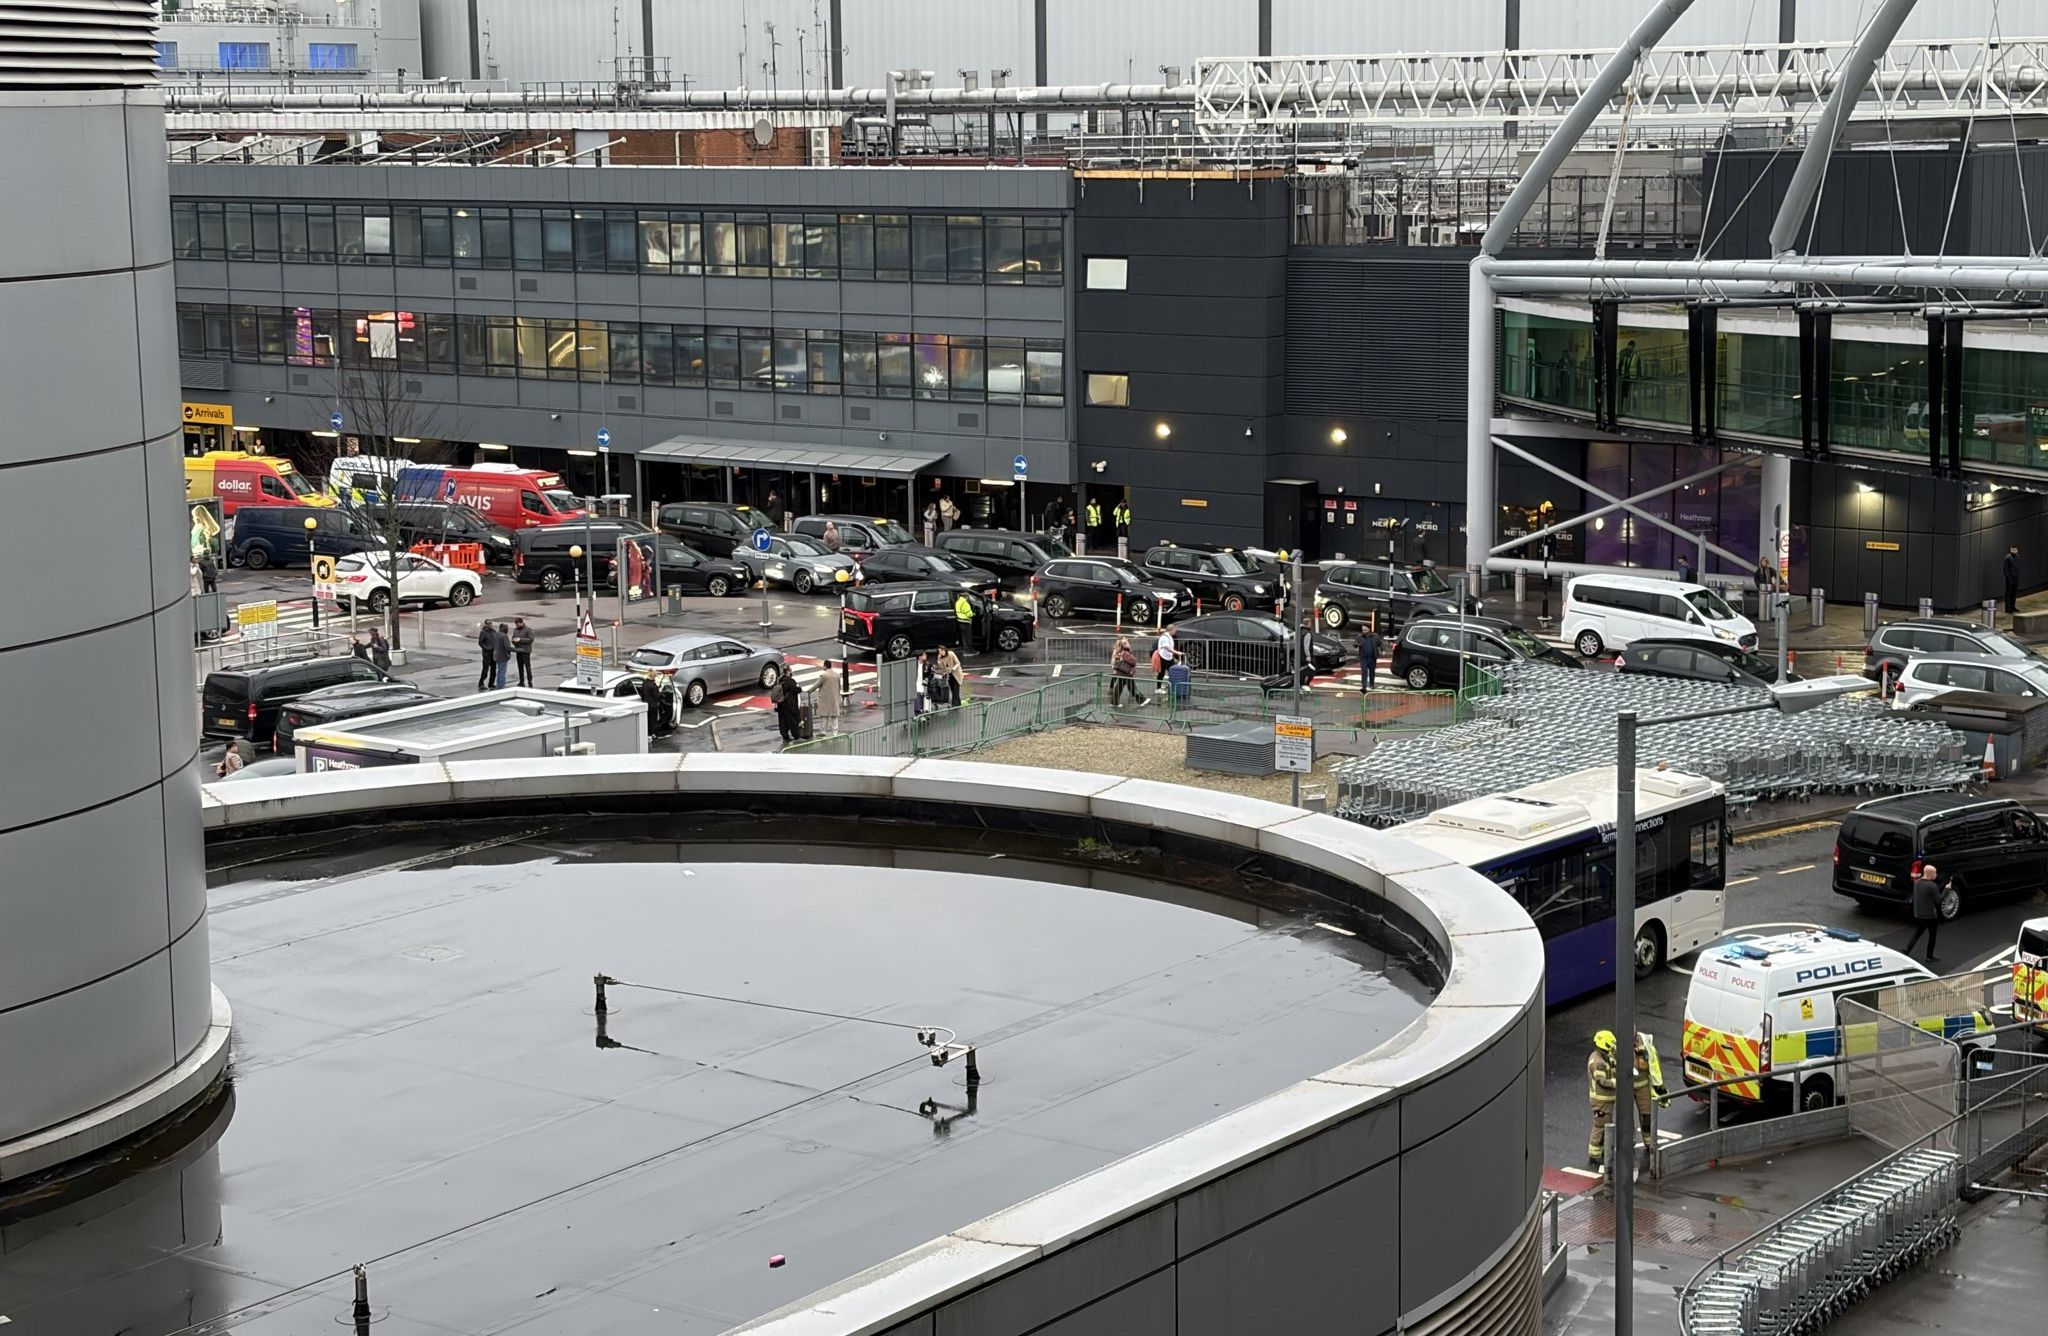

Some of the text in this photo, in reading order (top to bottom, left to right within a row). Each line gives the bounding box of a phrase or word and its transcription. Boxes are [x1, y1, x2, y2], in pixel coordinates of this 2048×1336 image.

[195, 408, 225, 419] Arrivals
[458, 495, 492, 511] AVIS
[1679, 513, 1712, 522] Heathrow
[1416, 523, 1438, 531] NERO
[1555, 533, 1573, 541] ERO
[1635, 815, 1664, 833] nnections
[1699, 967, 1718, 980] POLICE
[1797, 957, 1882, 983] POLICE
[1731, 976, 1756, 990] POLICE
